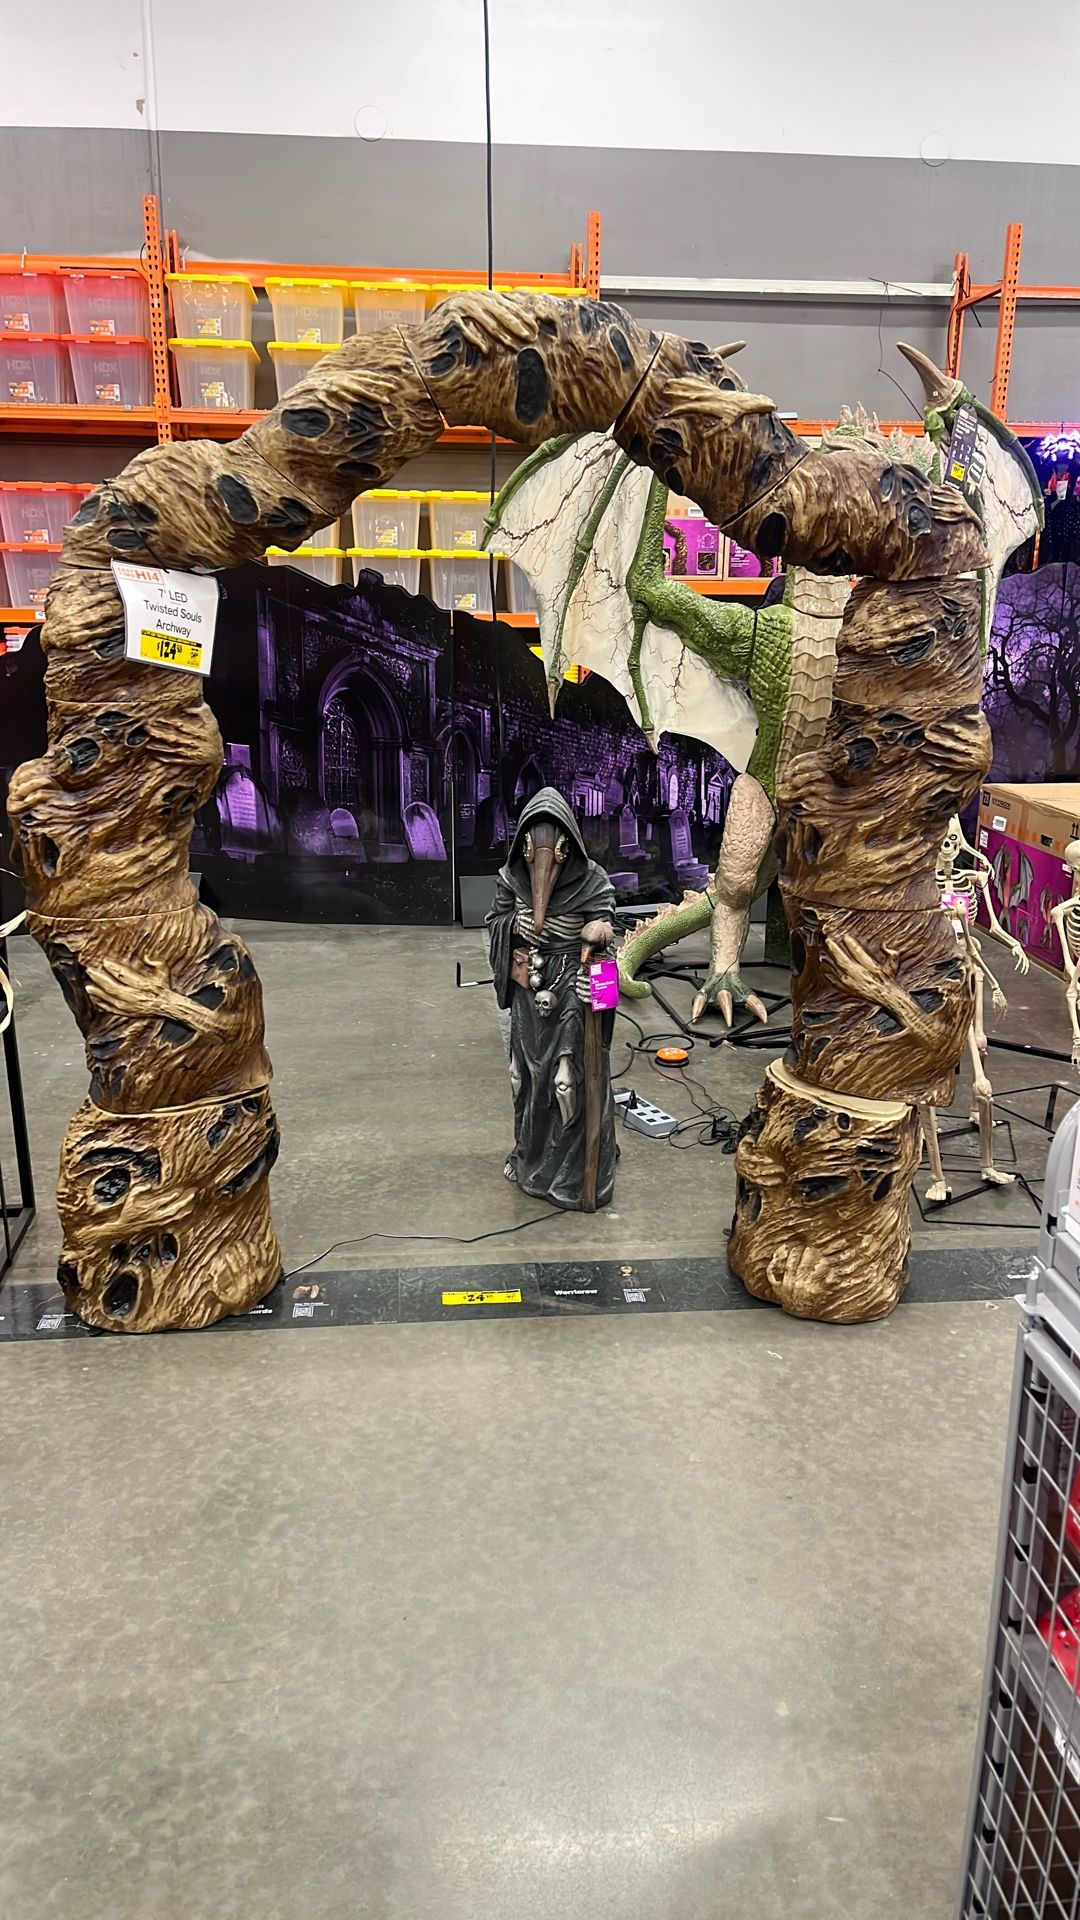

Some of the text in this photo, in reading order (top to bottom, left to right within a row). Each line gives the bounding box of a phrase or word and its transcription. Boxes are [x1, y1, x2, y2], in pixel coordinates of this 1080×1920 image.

[7, 359, 31, 370] HDX
[93, 361, 118, 373] HDX
[169, 590, 188, 603] LED
[144, 599, 202, 624] Twisted Souls
[156, 618, 191, 638] Archway
